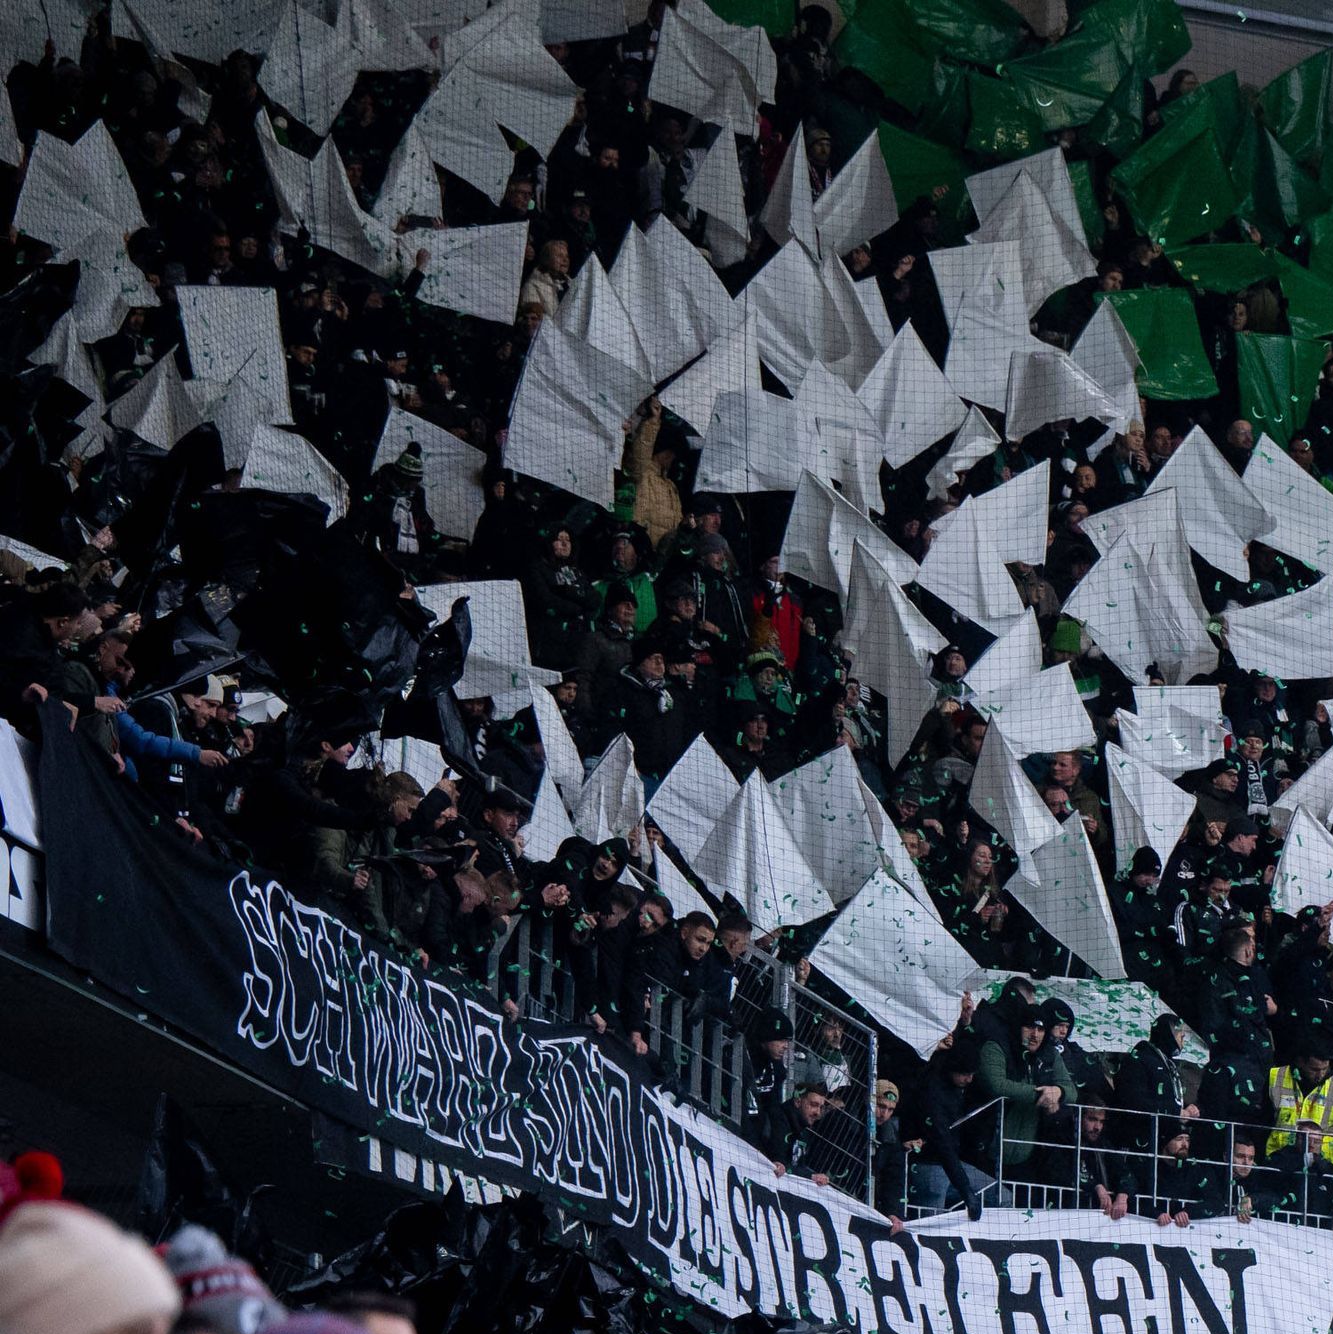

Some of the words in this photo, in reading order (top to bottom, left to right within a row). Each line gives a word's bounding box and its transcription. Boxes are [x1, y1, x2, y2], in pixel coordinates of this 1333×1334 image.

[229, 870, 523, 1167] SCHWARZ
[519, 1036, 641, 1229] SIND
[640, 1084, 726, 1289] DIE
